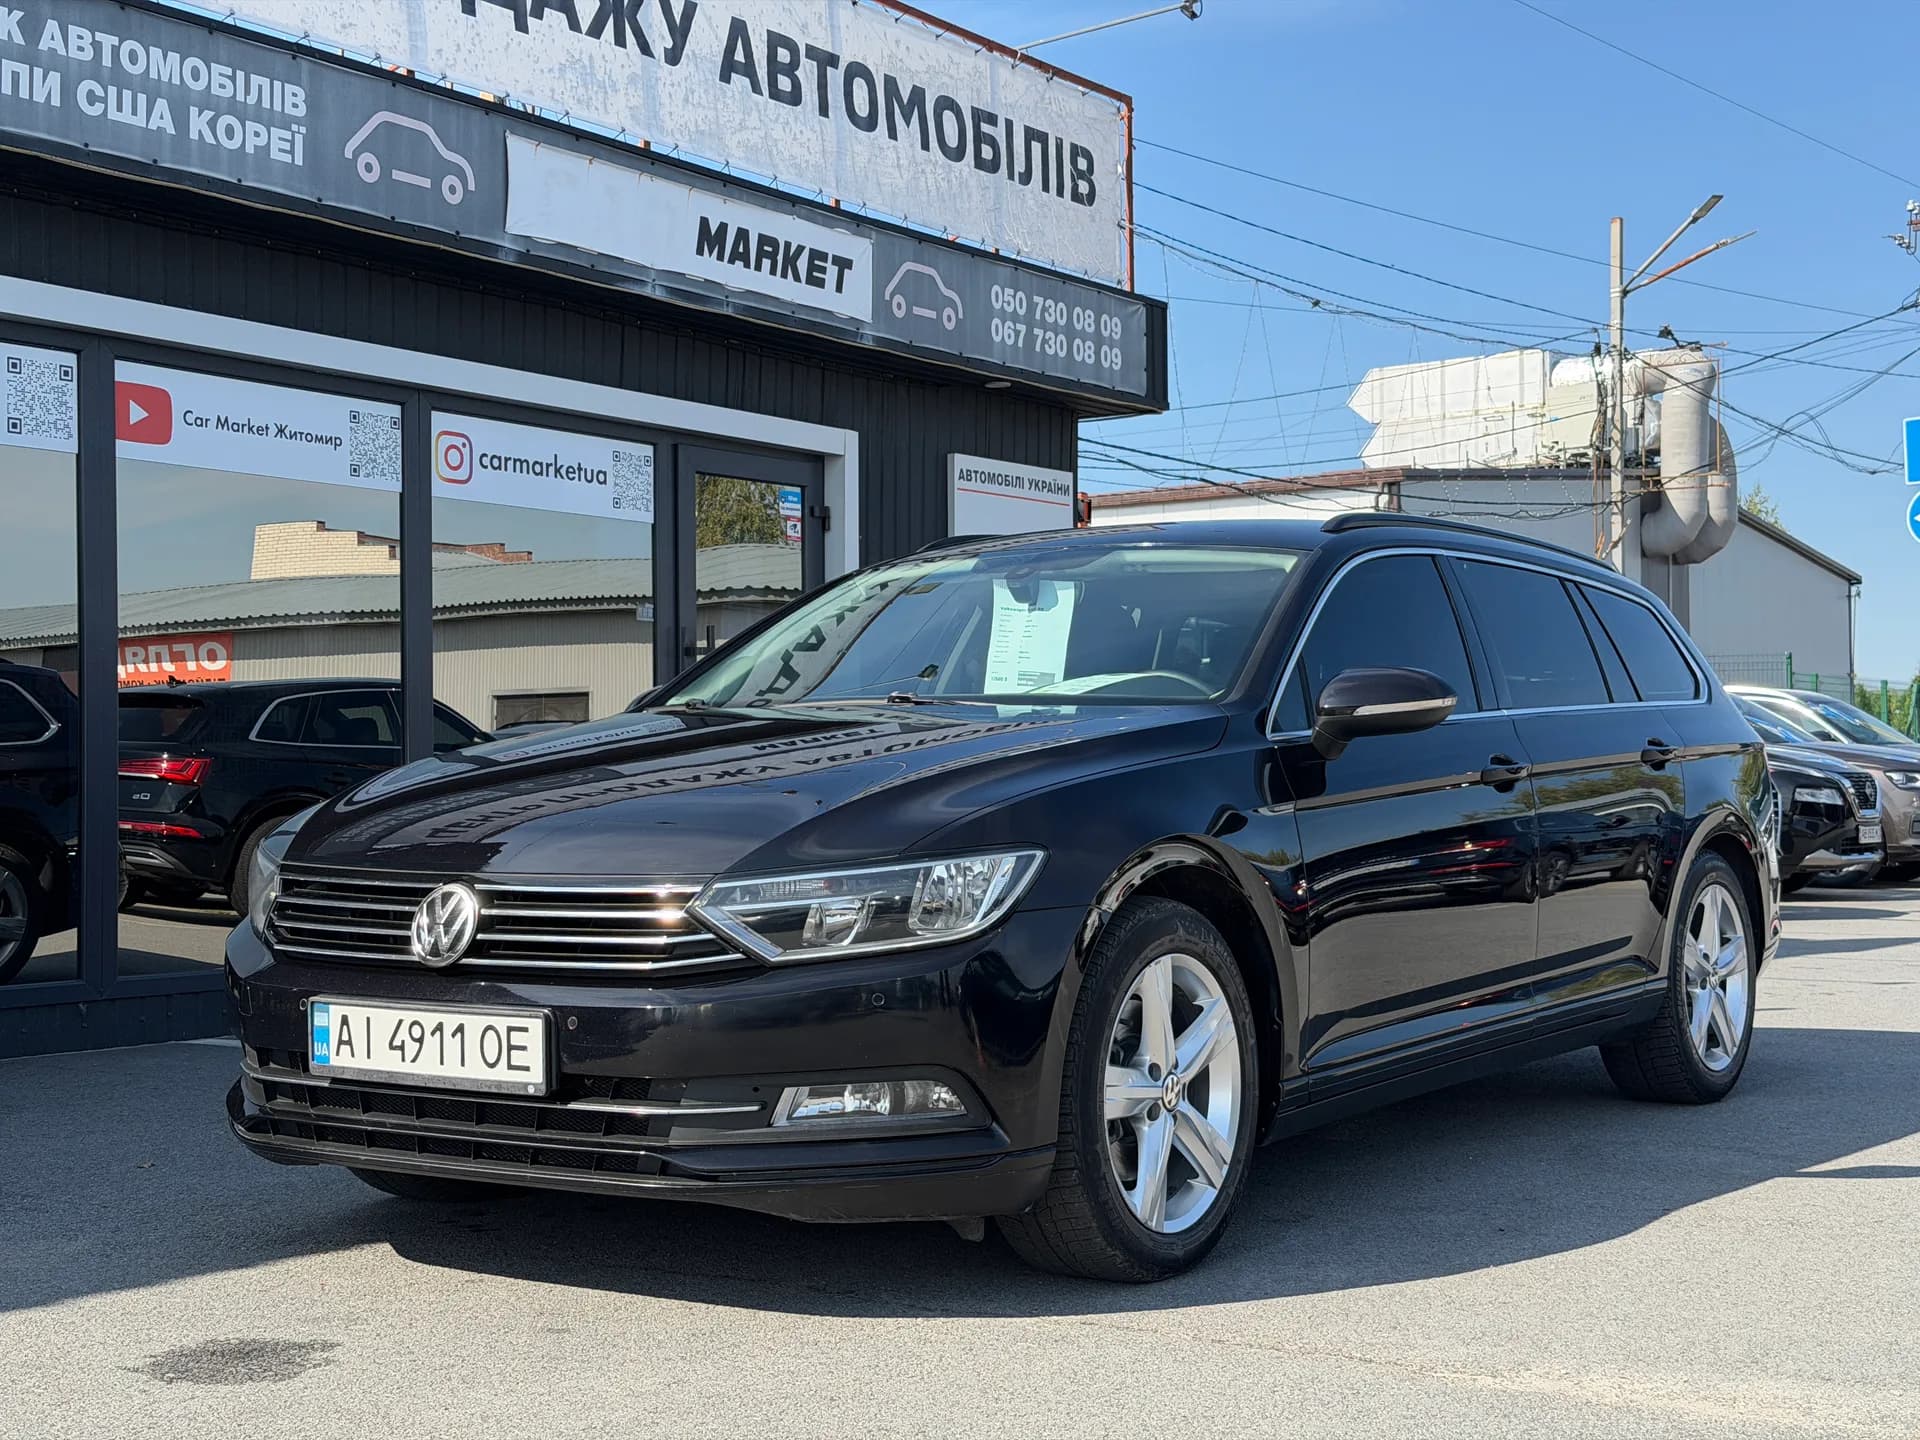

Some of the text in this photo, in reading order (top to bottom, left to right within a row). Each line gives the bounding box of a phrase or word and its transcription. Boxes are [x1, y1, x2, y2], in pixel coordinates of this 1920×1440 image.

[38, 19, 307, 117] АВТОМОБІЛІВ
[1, 59, 307, 166] ПИ США КОРЕЇ
[460, 0, 1097, 208] ЖУ АВТОМОБІЛІВ
[695, 215, 854, 294] MARKET
[991, 284, 1122, 340] 050 730 08 09
[991, 317, 1122, 370] 067 730 08 09
[183, 409, 343, 451] Car Market Житомир
[478, 453, 608, 486] carmarketua
[958, 467, 1070, 497] АВТОМОБІЛІ УКРАЇНИ
[314, 1041, 329, 1056] UA
[335, 1014, 532, 1072] AI 4911 OE
